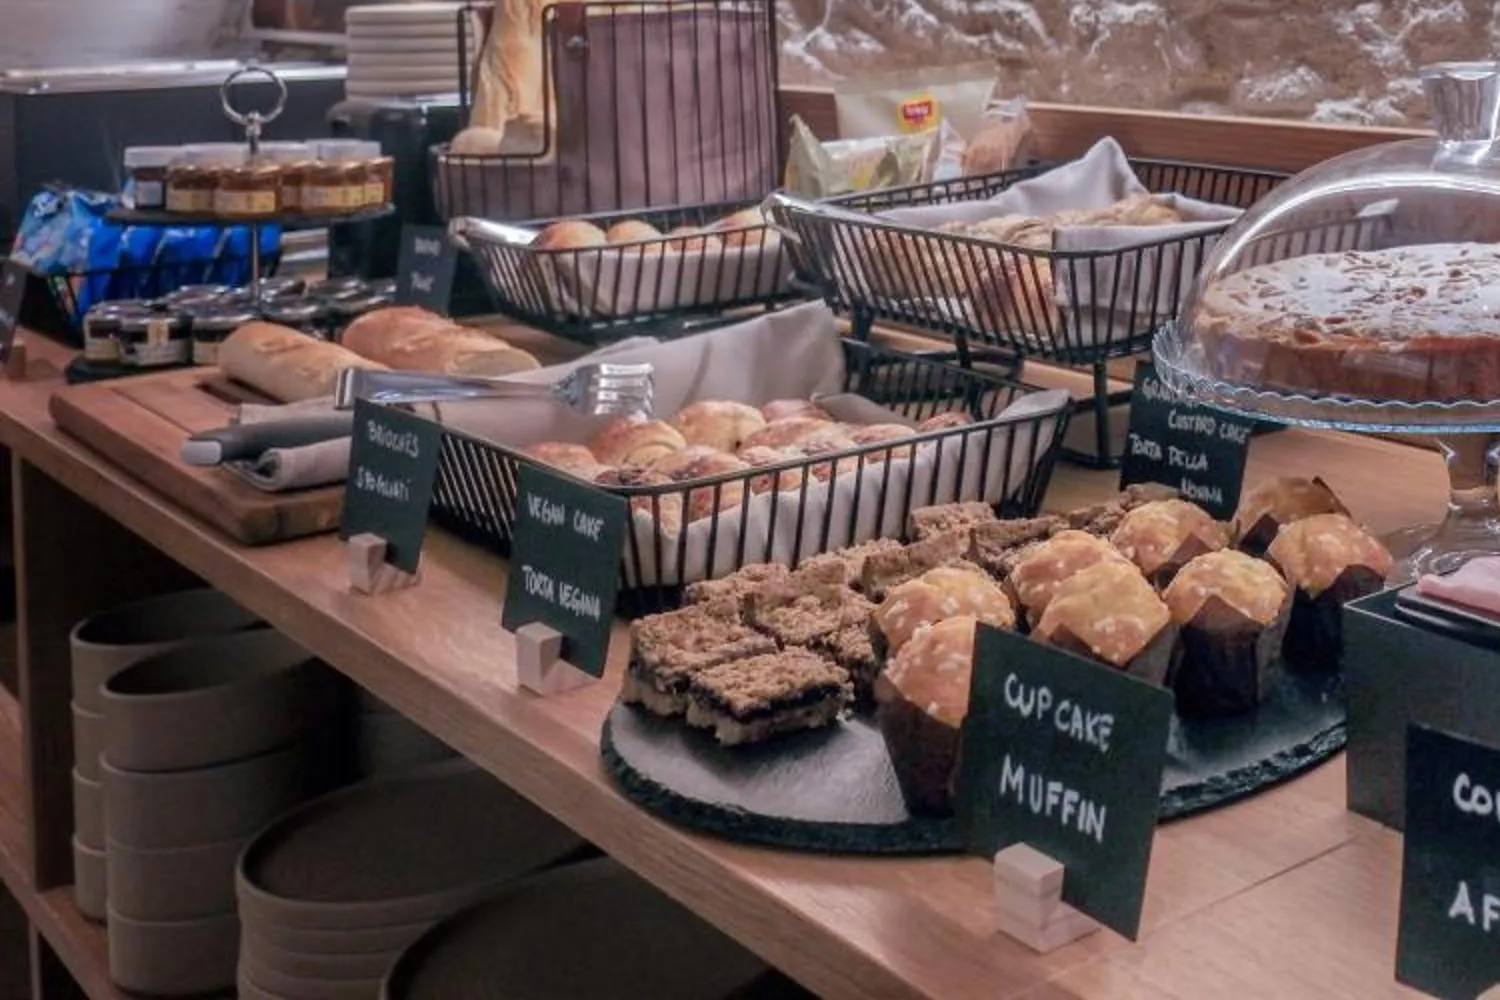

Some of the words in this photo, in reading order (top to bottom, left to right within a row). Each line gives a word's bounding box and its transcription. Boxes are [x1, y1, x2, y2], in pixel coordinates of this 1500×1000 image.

[526, 491, 565, 526] VEGAN
[573, 508, 605, 542] CAKE
[521, 564, 555, 604] TORTA
[999, 752, 1107, 844] MUFFIN
